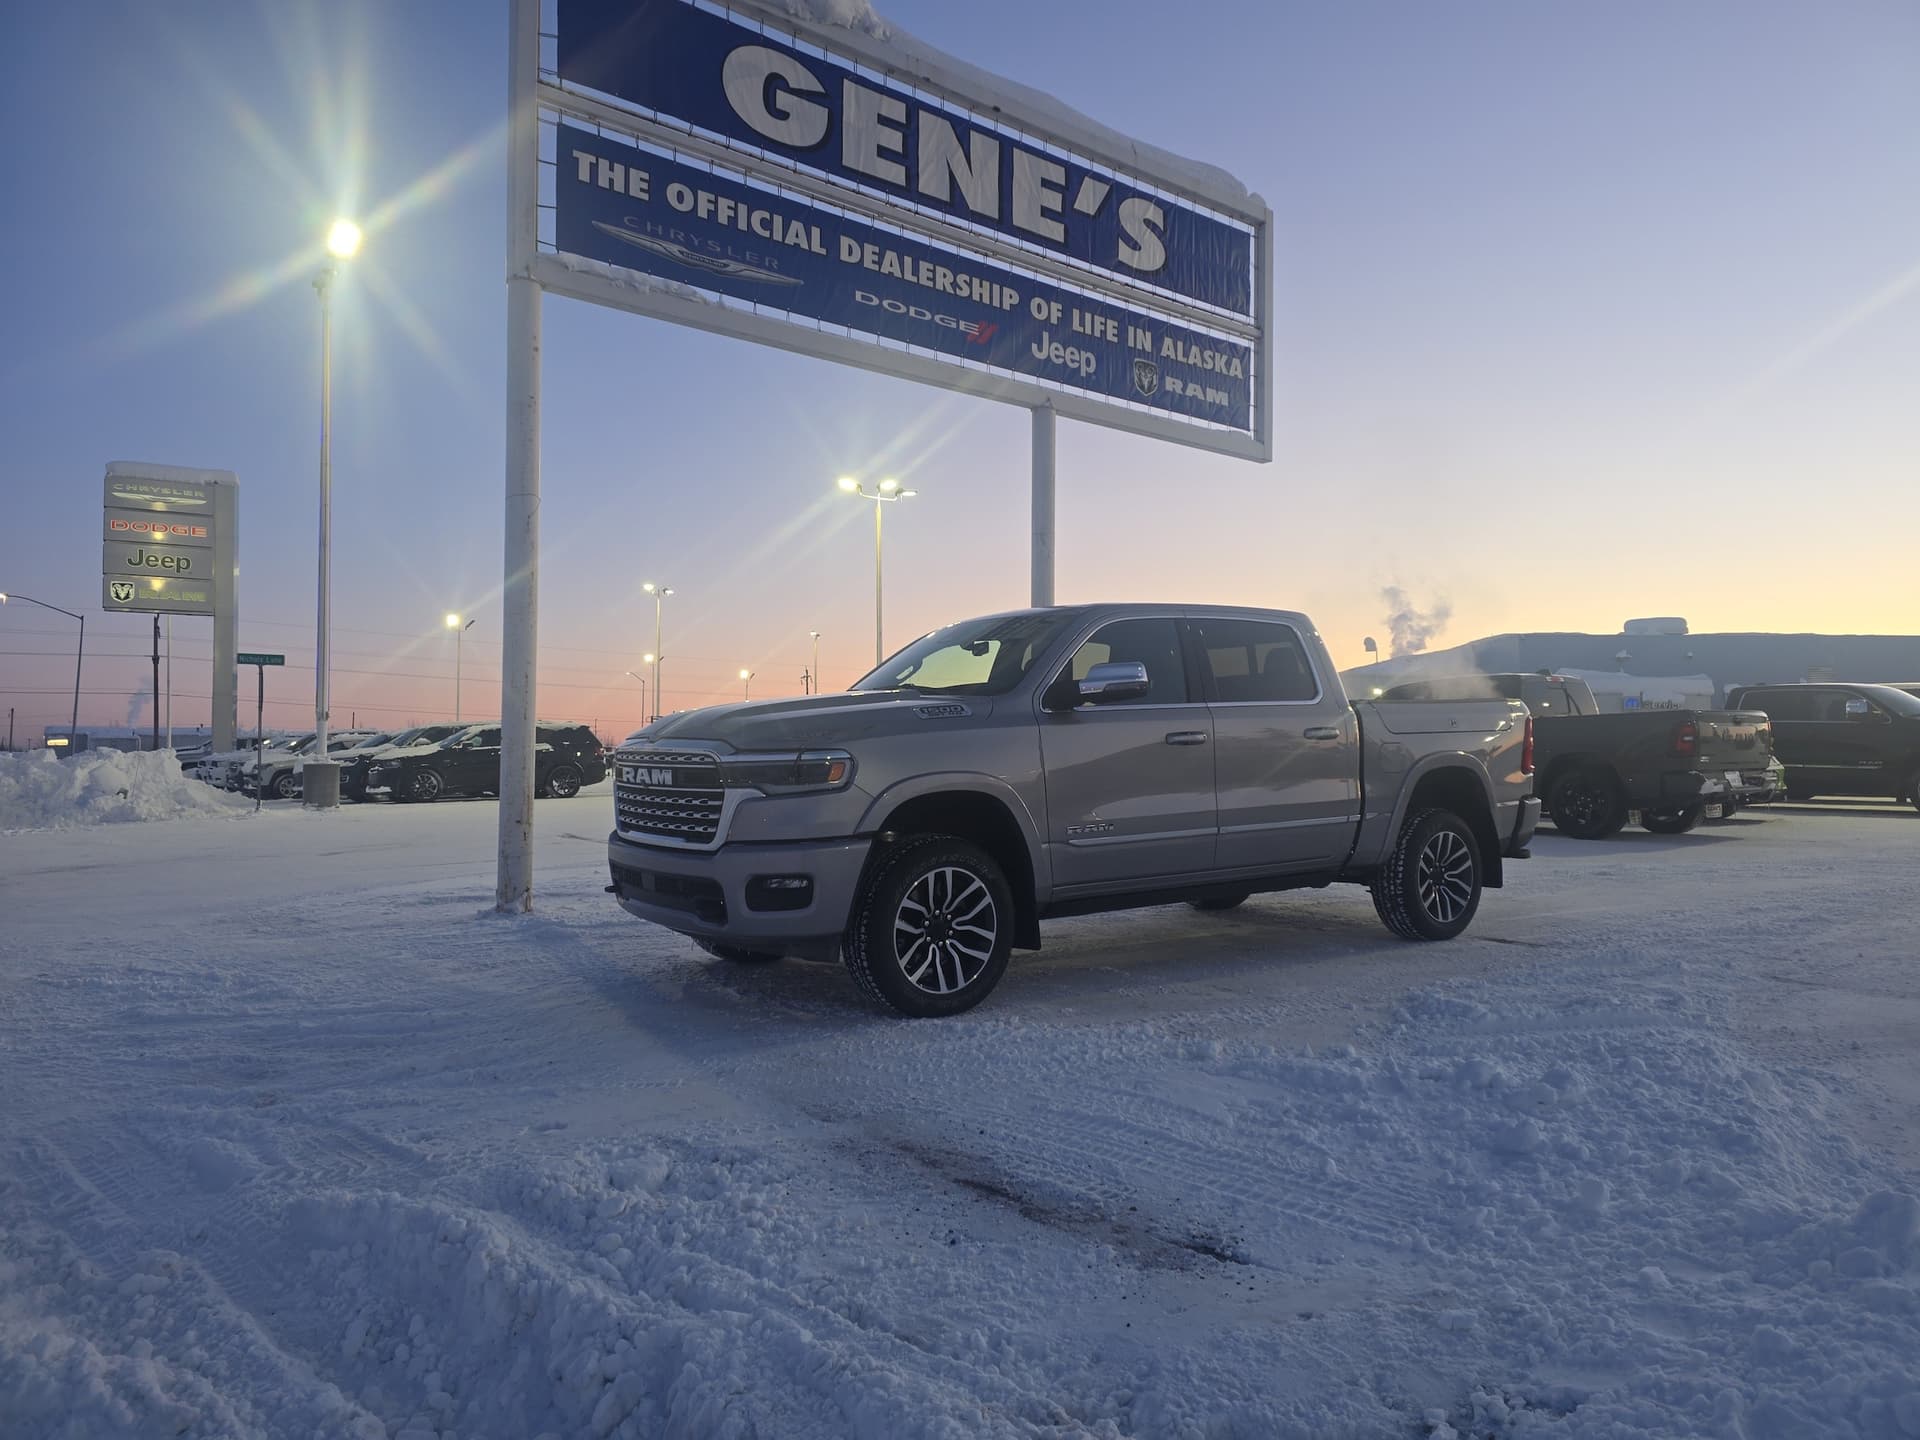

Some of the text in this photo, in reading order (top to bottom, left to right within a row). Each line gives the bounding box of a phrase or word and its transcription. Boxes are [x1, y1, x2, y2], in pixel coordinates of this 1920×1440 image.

[722, 45, 1167, 272] GENE'S
[623, 215, 779, 270] CHRYSLER
[572, 149, 1243, 379] THE OFFICIAL DEALERSHIP OF LIFE IN ALASKA
[855, 290, 981, 336] DODGE
[1031, 331, 1097, 377] Jeep
[1165, 376, 1229, 406] RAM
[113, 483, 205, 498] CHRYSLER
[111, 519, 208, 537] DODGE
[127, 549, 192, 574] Jeep
[622, 767, 673, 785] RAM
[1066, 823, 1114, 834] RAM
